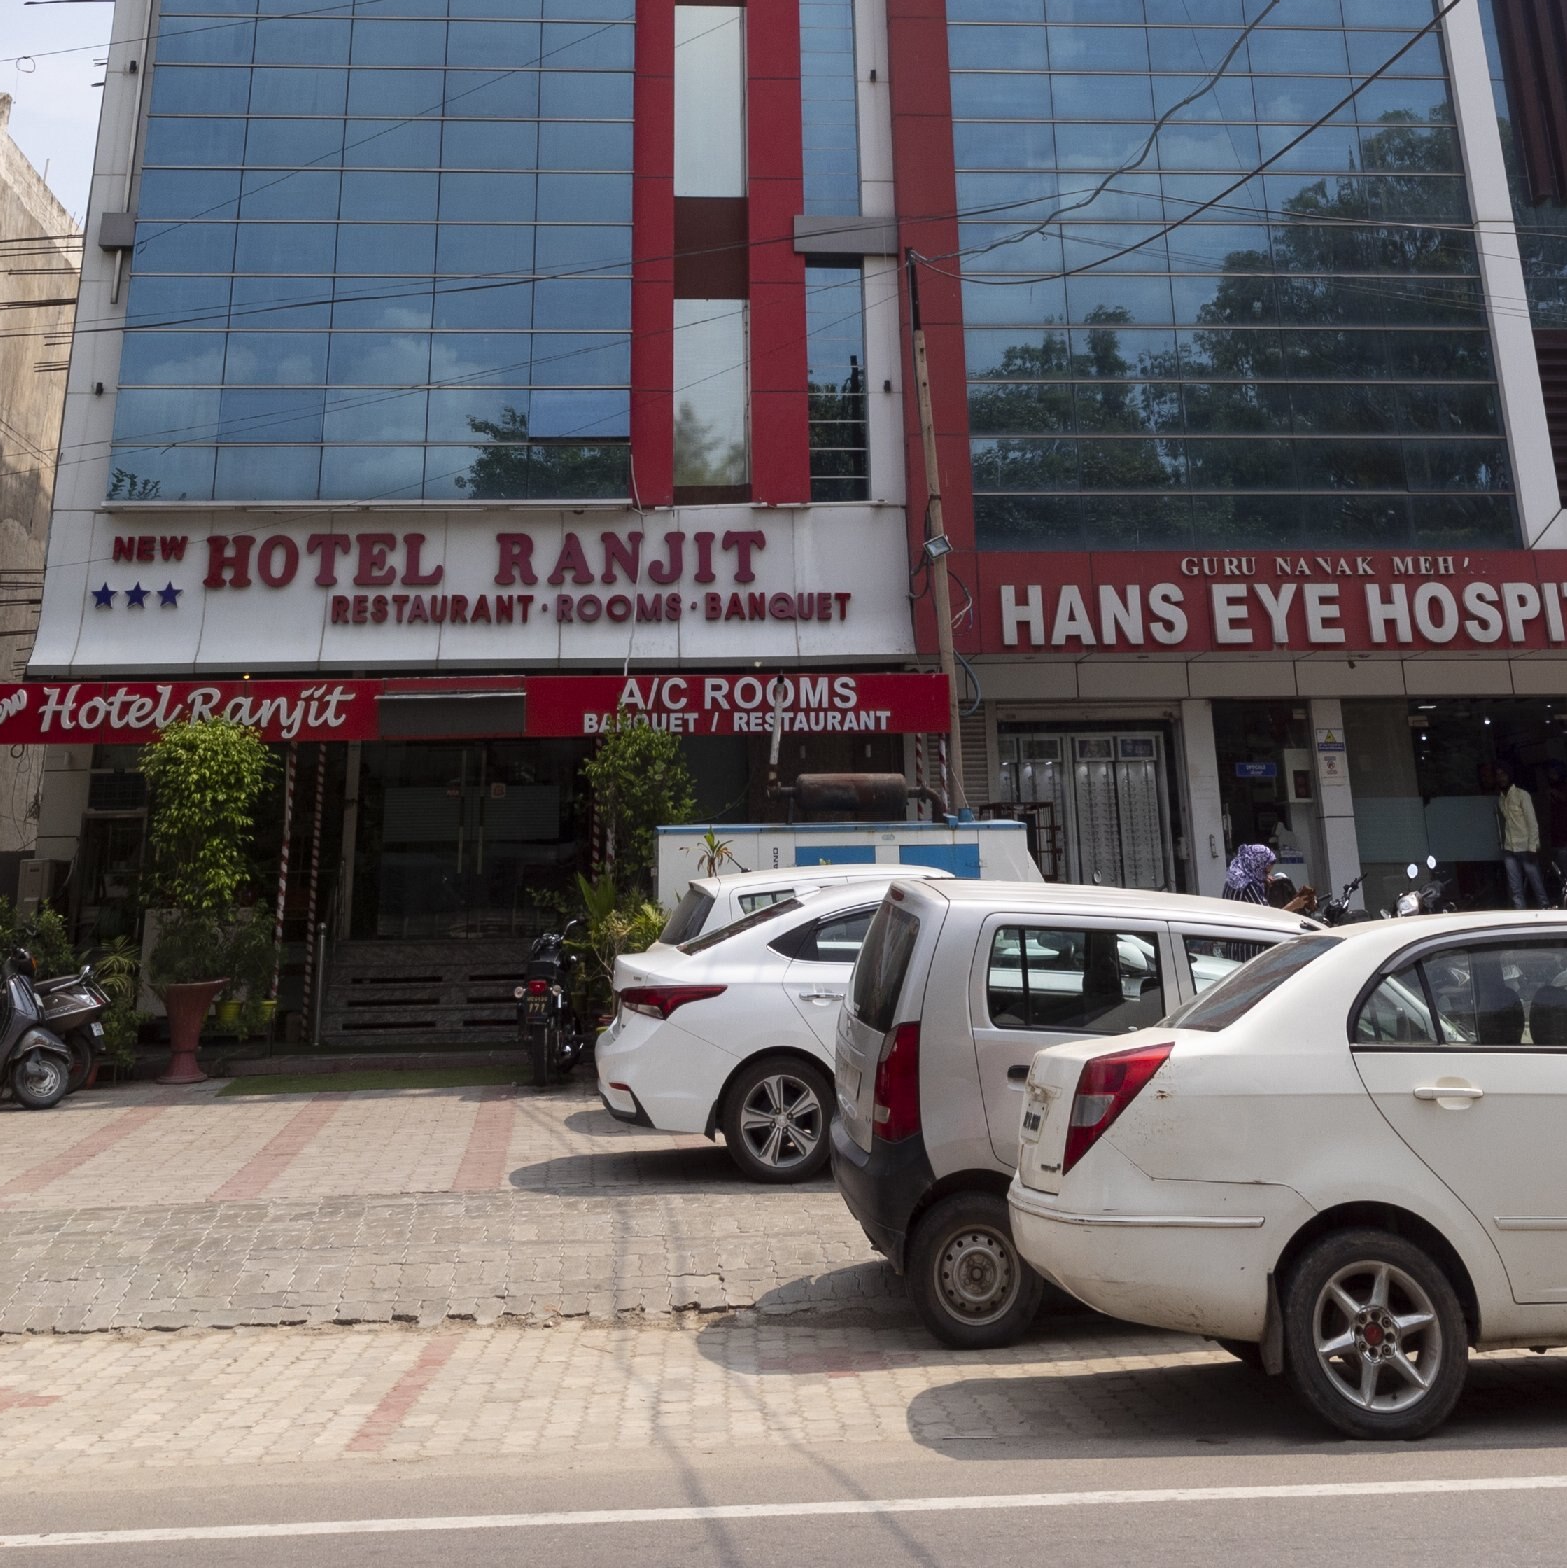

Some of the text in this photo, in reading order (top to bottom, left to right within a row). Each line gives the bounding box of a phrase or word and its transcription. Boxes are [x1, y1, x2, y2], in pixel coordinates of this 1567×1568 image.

[112, 530, 767, 589] NEW HOTEL RANJIT
[1181, 555, 1470, 576] GURU NANAK MEH
[332, 592, 852, 624] RESTAURANT ROOMS BANQUET
[1001, 583, 1194, 646] HANS
[1211, 581, 1346, 645] EYE
[619, 675, 858, 710] A/C ROOMS
[37, 684, 184, 733] Hotel
[186, 683, 357, 740] Ranjit
[733, 711, 891, 732] RESTAURANT
